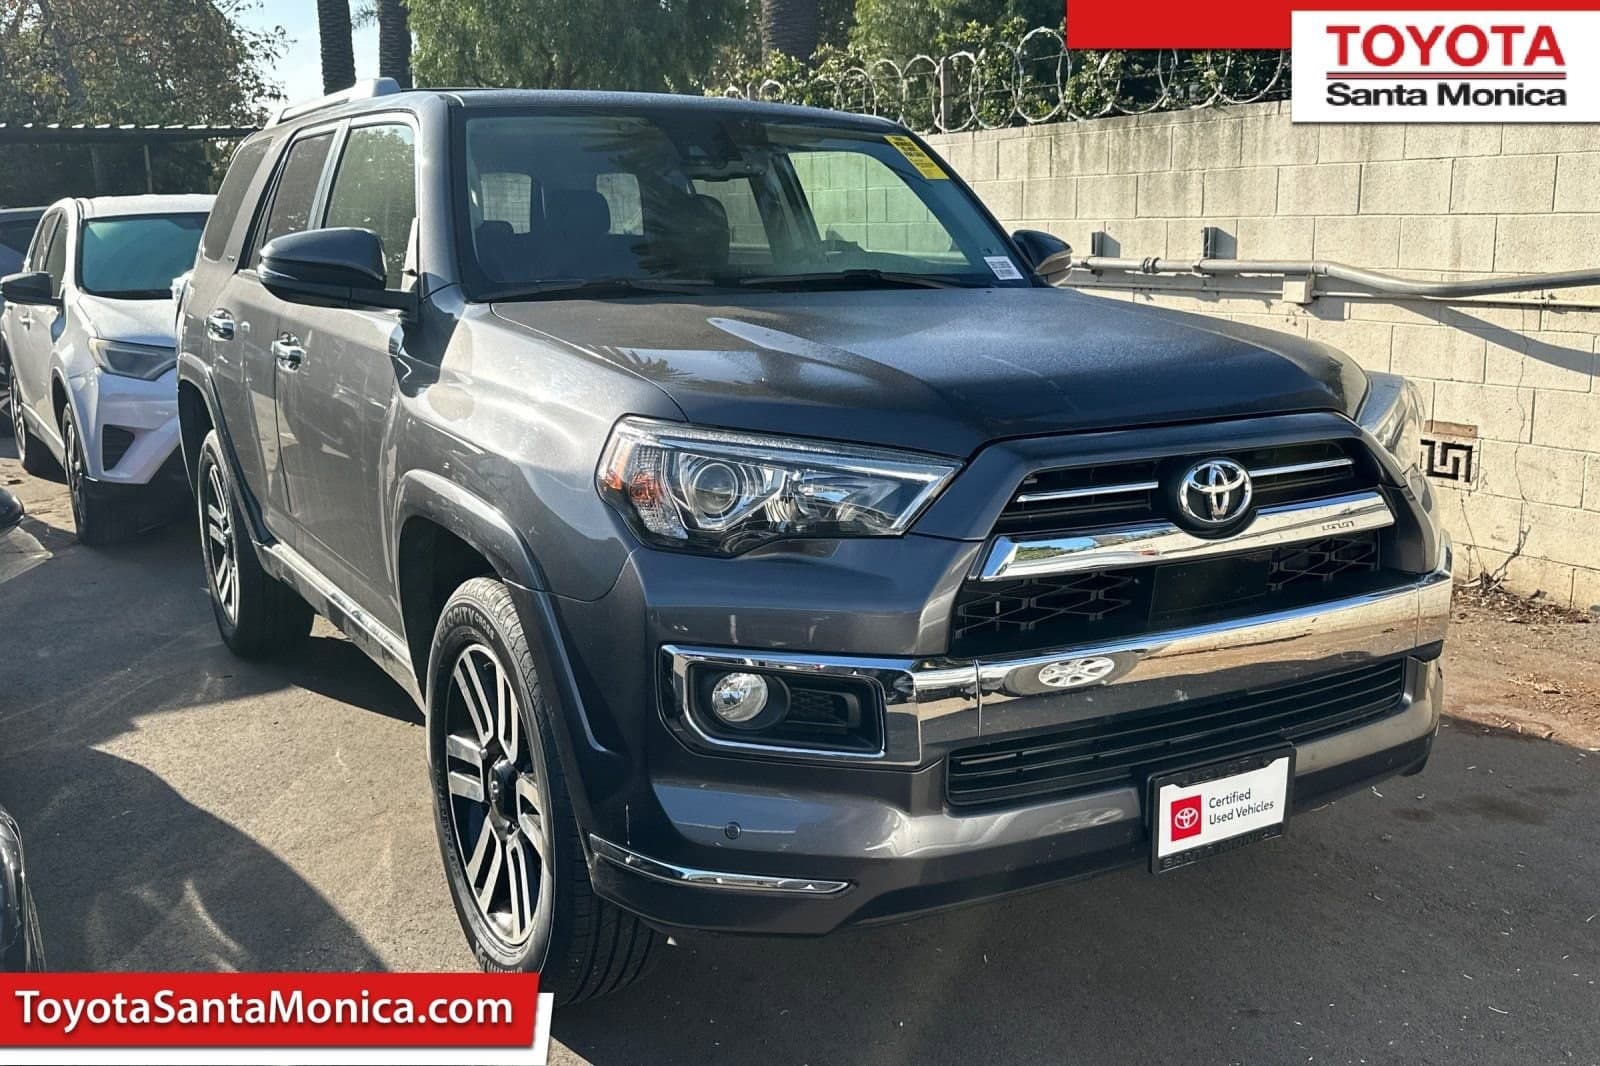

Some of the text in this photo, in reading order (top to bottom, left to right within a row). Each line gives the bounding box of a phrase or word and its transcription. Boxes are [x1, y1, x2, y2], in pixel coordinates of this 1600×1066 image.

[1208, 787, 1251, 808] Certified
[1209, 800, 1274, 825] Used Vehicles
